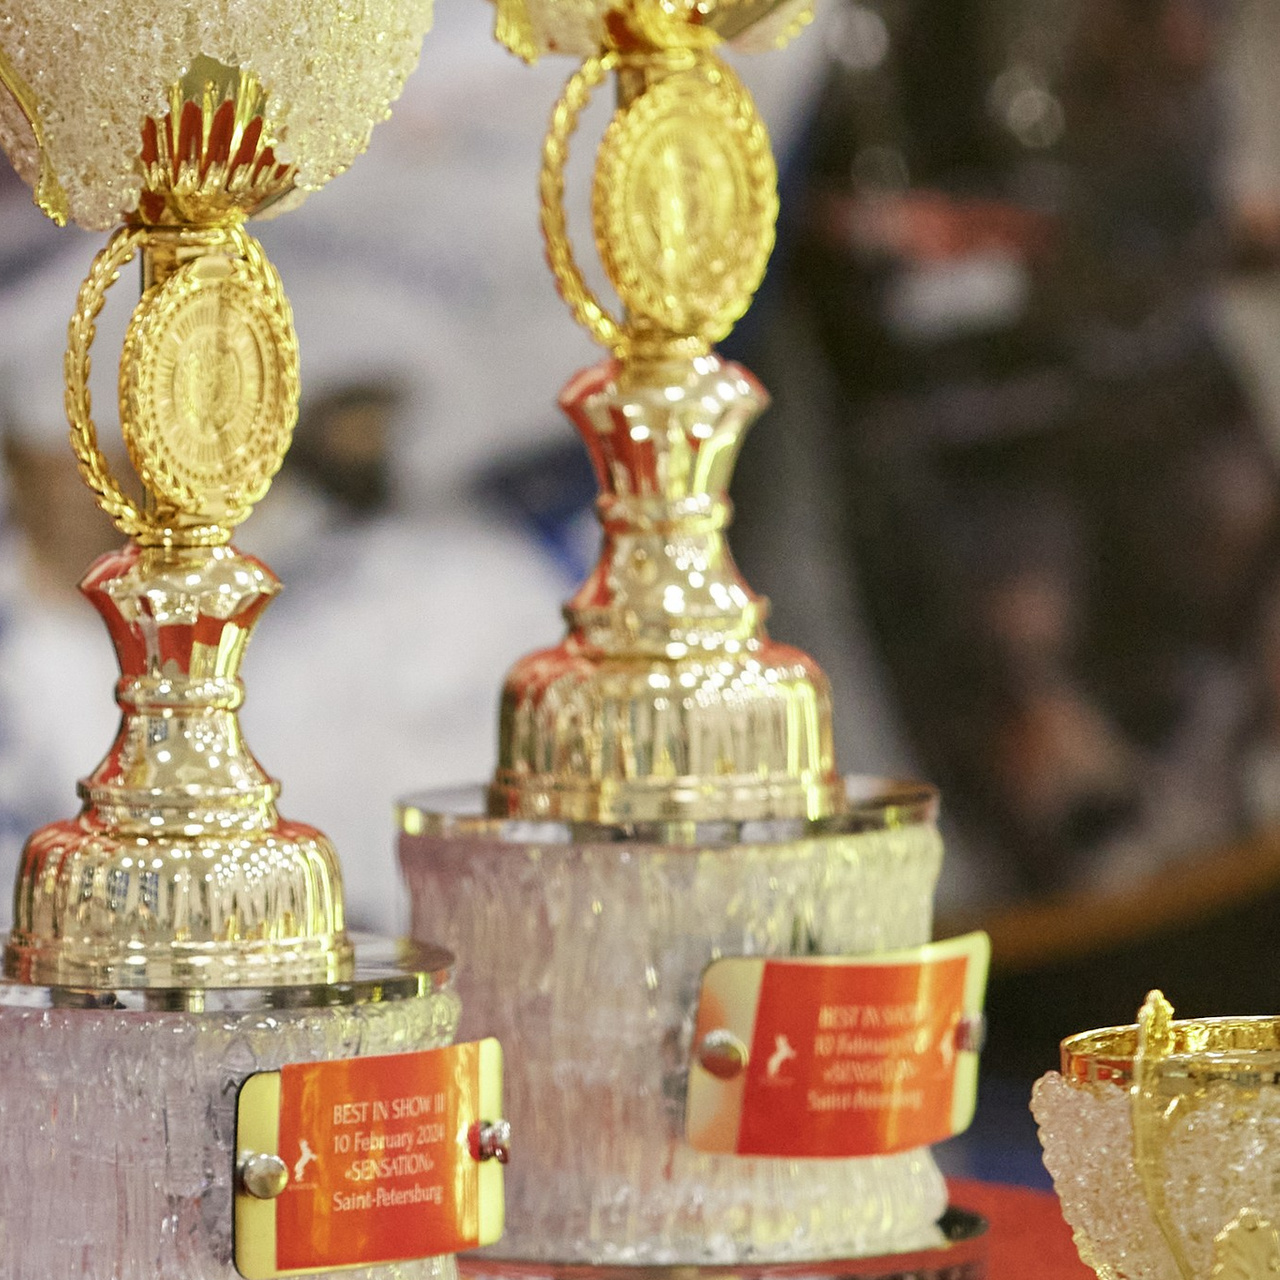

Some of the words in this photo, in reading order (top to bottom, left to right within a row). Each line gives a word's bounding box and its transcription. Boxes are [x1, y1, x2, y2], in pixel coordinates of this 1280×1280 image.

[333, 1101, 369, 1125] BEST
[372, 1100, 389, 1121] IN
[391, 1094, 431, 1120] SHOW
[333, 1133, 351, 1154] 10
[354, 1130, 413, 1152] February
[344, 1152, 435, 1182] «SENSATION»
[332, 1182, 444, 1212] Saint-Petersburg
